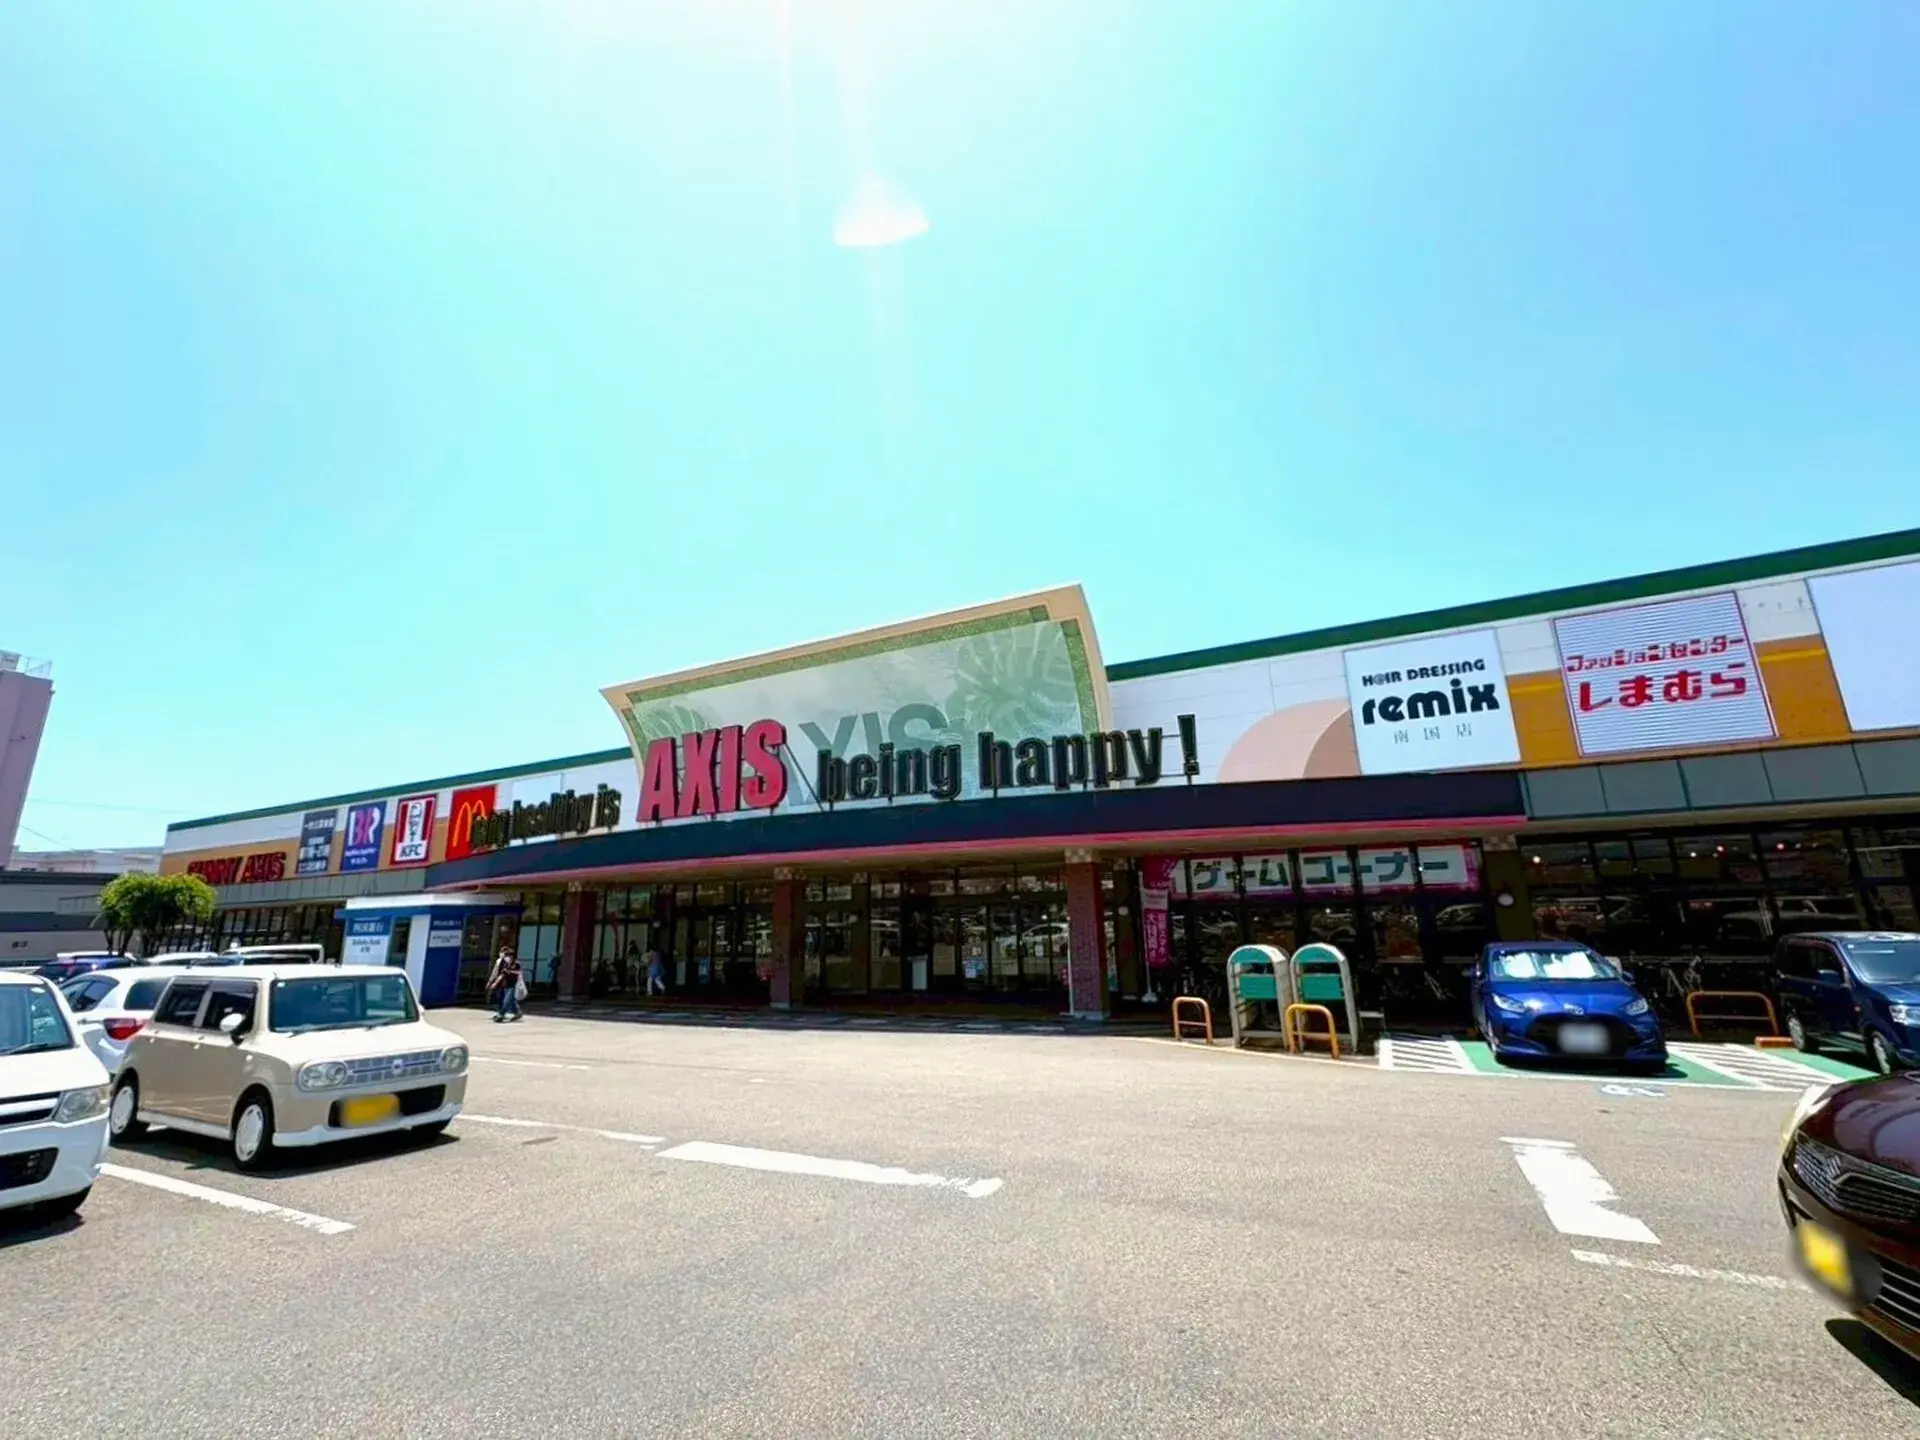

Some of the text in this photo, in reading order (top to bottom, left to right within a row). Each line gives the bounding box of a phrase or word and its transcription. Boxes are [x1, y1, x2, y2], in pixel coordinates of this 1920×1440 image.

[1406, 658, 1486, 680] DRESSING
[1566, 634, 1745, 673] ファッションセンター
[1362, 678, 1500, 725] remix
[1579, 662, 1747, 712] しまむら
[597, 783, 622, 828] is
[635, 718, 788, 822] AXIS
[817, 742, 962, 803] being
[241, 851, 287, 884] AXIS
[399, 843, 423, 858] KFC
[1193, 852, 1450, 891] ゲームコーナー
